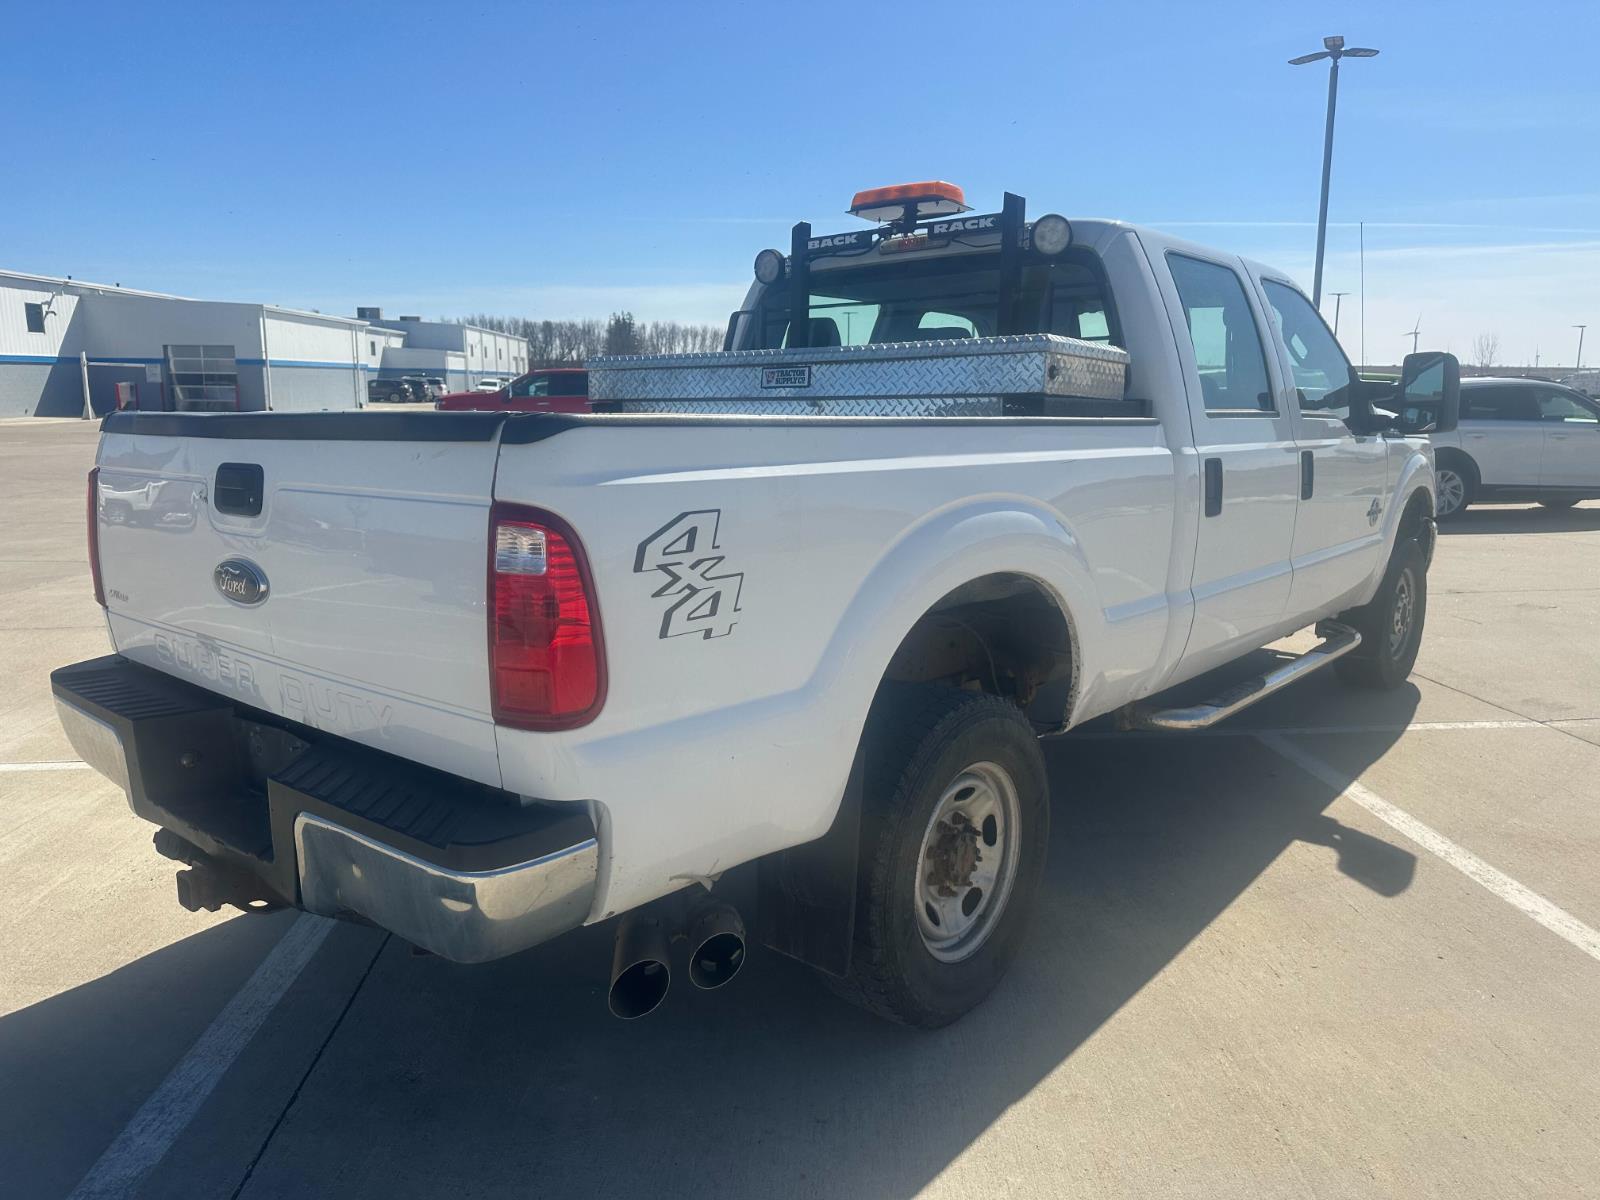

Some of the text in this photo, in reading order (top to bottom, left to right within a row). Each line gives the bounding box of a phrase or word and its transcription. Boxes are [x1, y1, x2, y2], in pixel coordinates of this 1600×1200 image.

[807, 216, 996, 250] BACK RACK
[775, 369, 806, 377] TRACTOR
[775, 377, 798, 385] SUPPLY
[216, 566, 247, 595] Ford
[153, 633, 394, 739] SUPER DUTY
